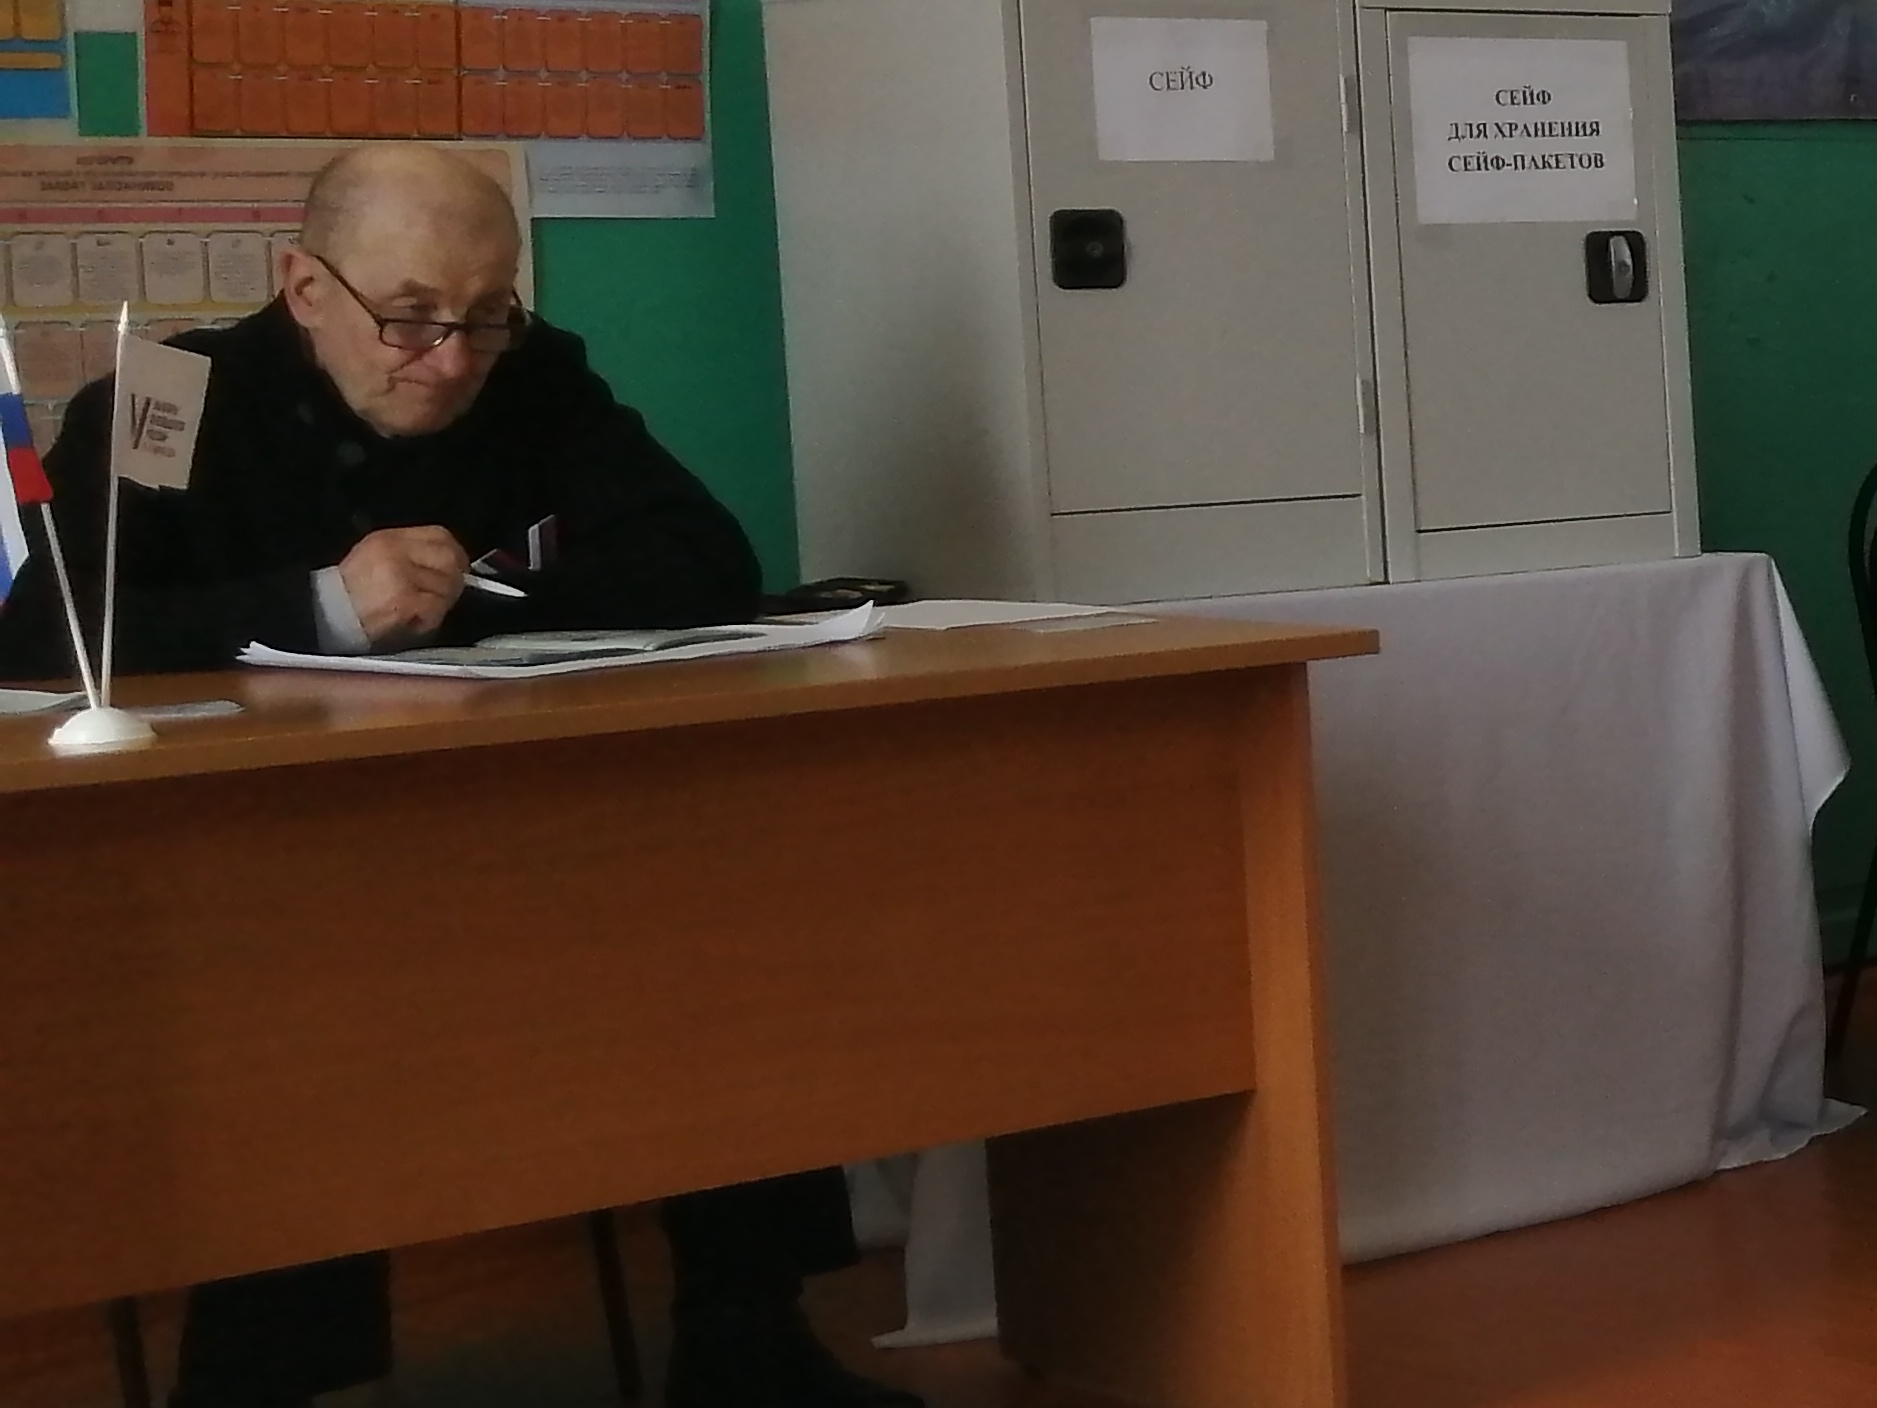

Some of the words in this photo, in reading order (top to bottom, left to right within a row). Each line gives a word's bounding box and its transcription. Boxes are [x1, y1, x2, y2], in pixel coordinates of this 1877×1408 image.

[1148, 66, 1214, 92] СЕЙФ
[1494, 85, 1552, 107] СЕЙФ
[1447, 120, 1488, 142] ДЛЯ
[1493, 120, 1601, 139] ХРАНЕНИЯ
[1447, 150, 1606, 173] СЕЙФ-ПАКЕТОВ
